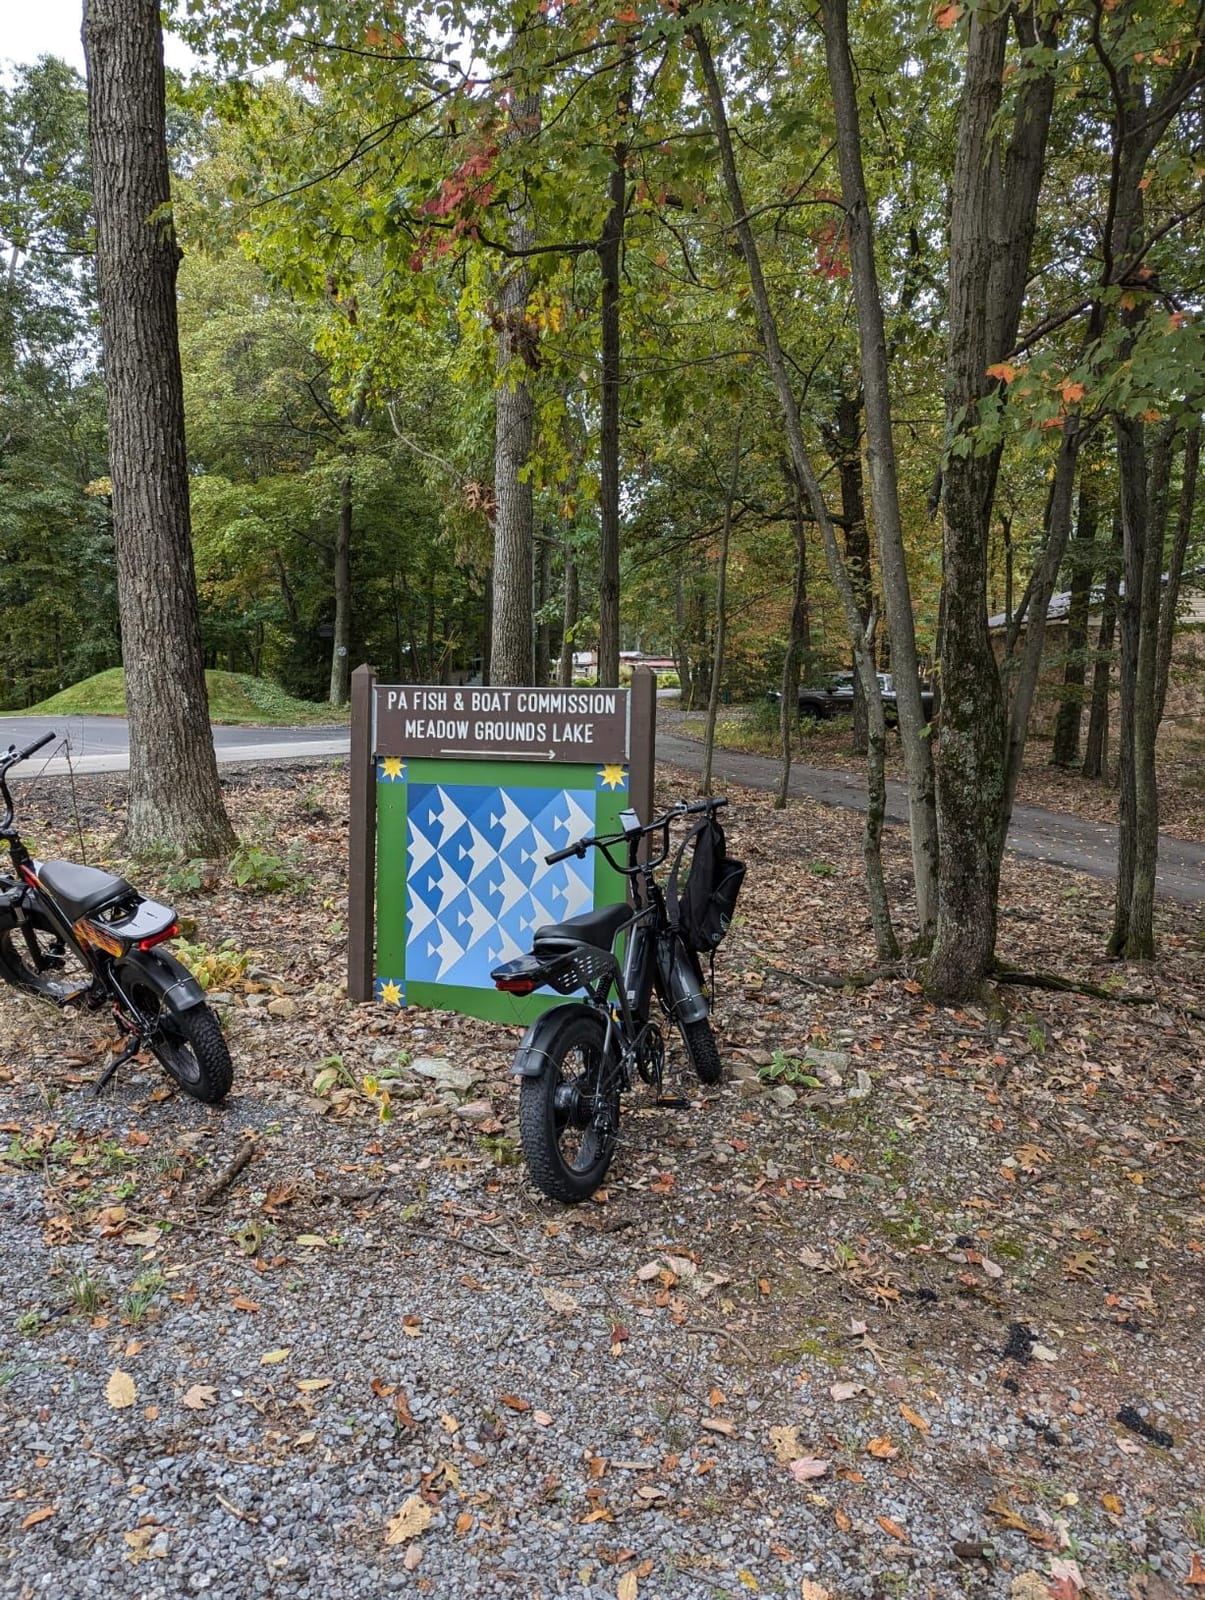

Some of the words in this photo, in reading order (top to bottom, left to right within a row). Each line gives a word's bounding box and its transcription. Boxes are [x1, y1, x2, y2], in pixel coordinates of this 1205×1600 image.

[387, 691, 408, 711] PA
[413, 691, 447, 711] FISH
[453, 692, 465, 711] &
[471, 692, 512, 712] BOAT
[517, 693, 616, 714] COMMISSION
[405, 720, 470, 740] MEADOW
[474, 721, 547, 742] GROUNDS
[552, 723, 594, 743] LAKE
